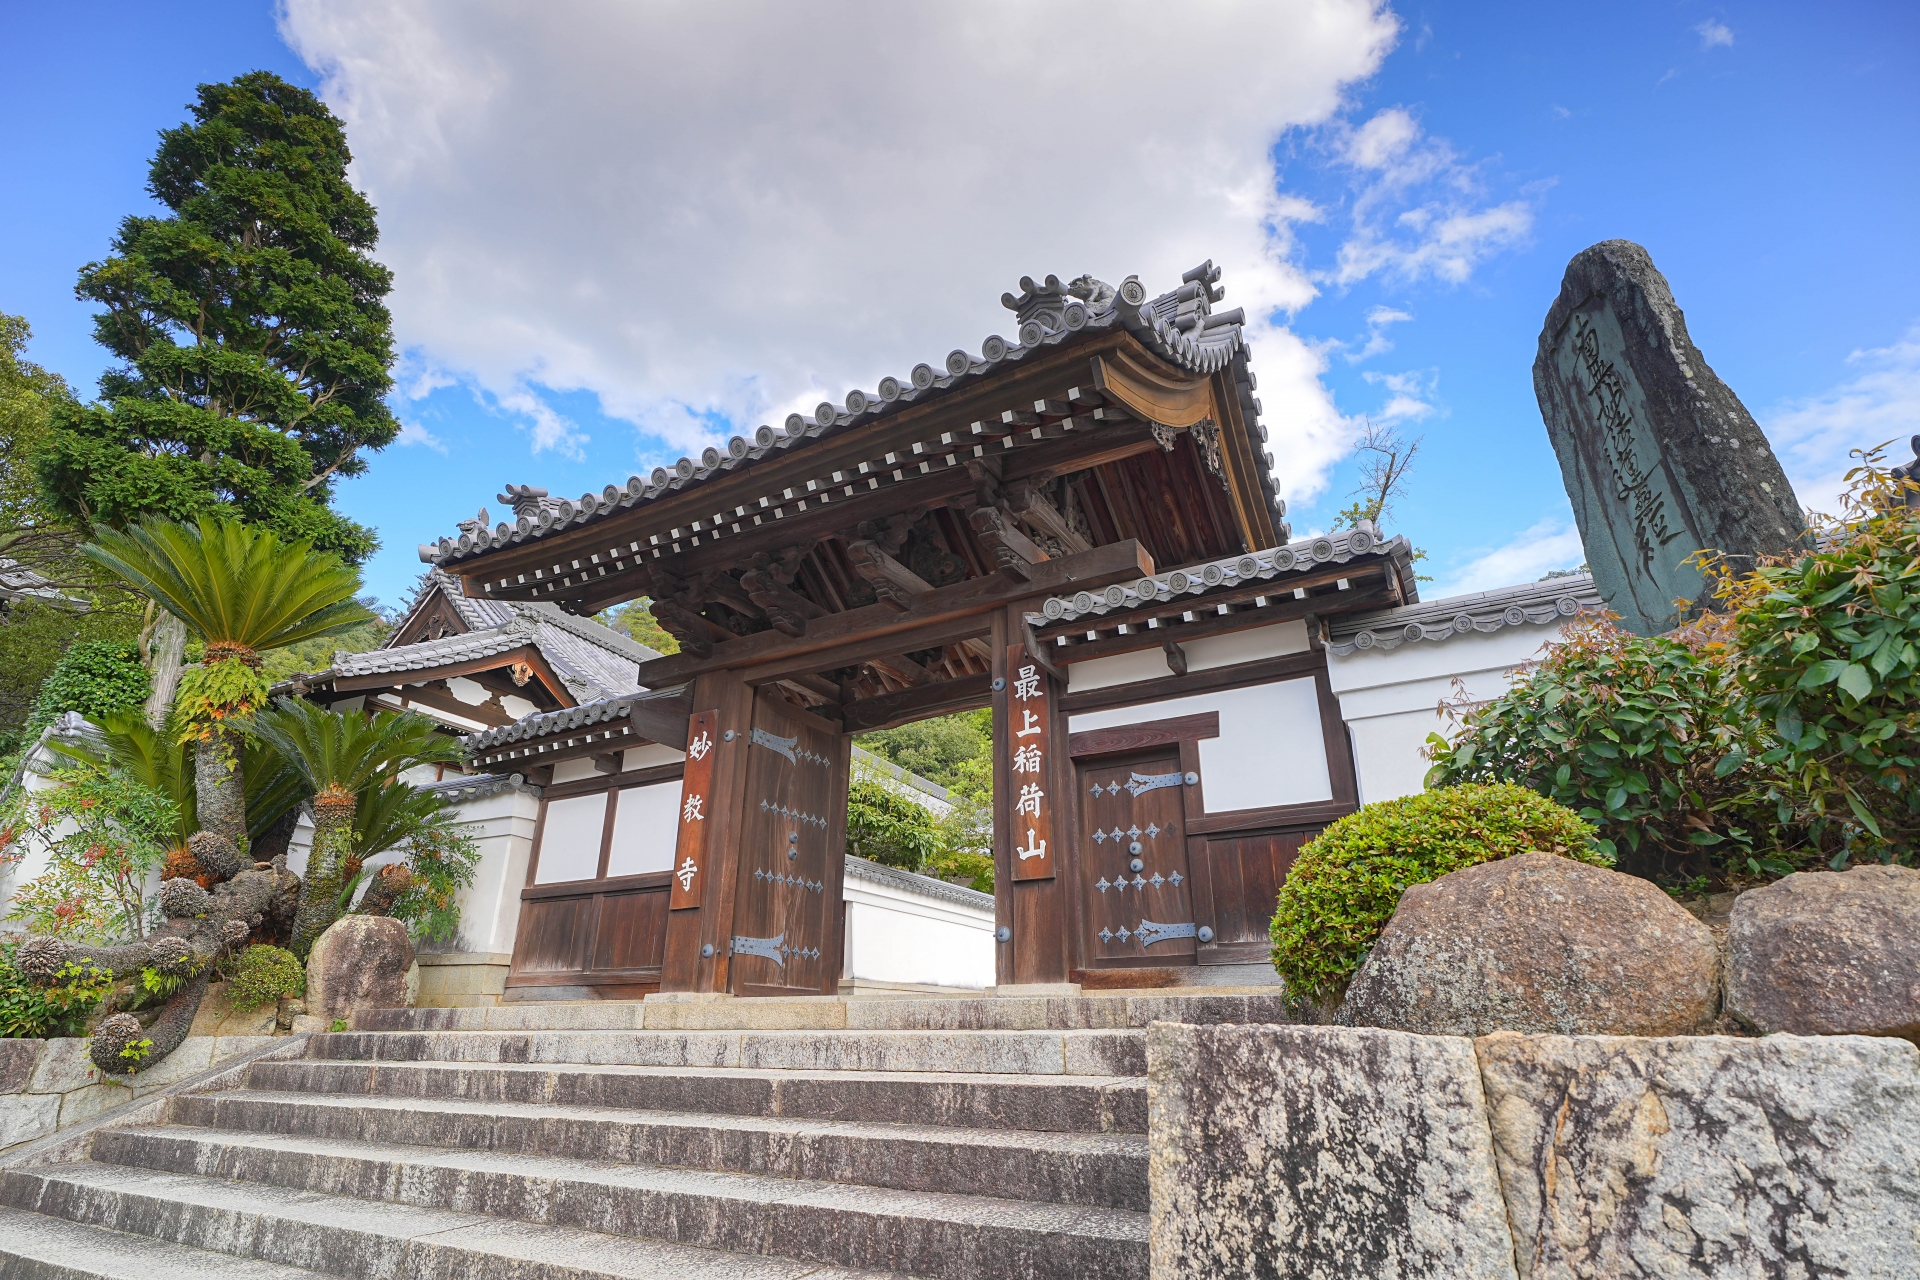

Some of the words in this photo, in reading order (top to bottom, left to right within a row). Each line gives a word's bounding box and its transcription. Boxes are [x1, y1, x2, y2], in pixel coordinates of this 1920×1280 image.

[676, 730, 713, 892] 妙教寺
[1012, 664, 1047, 861] 最上稲荷山
